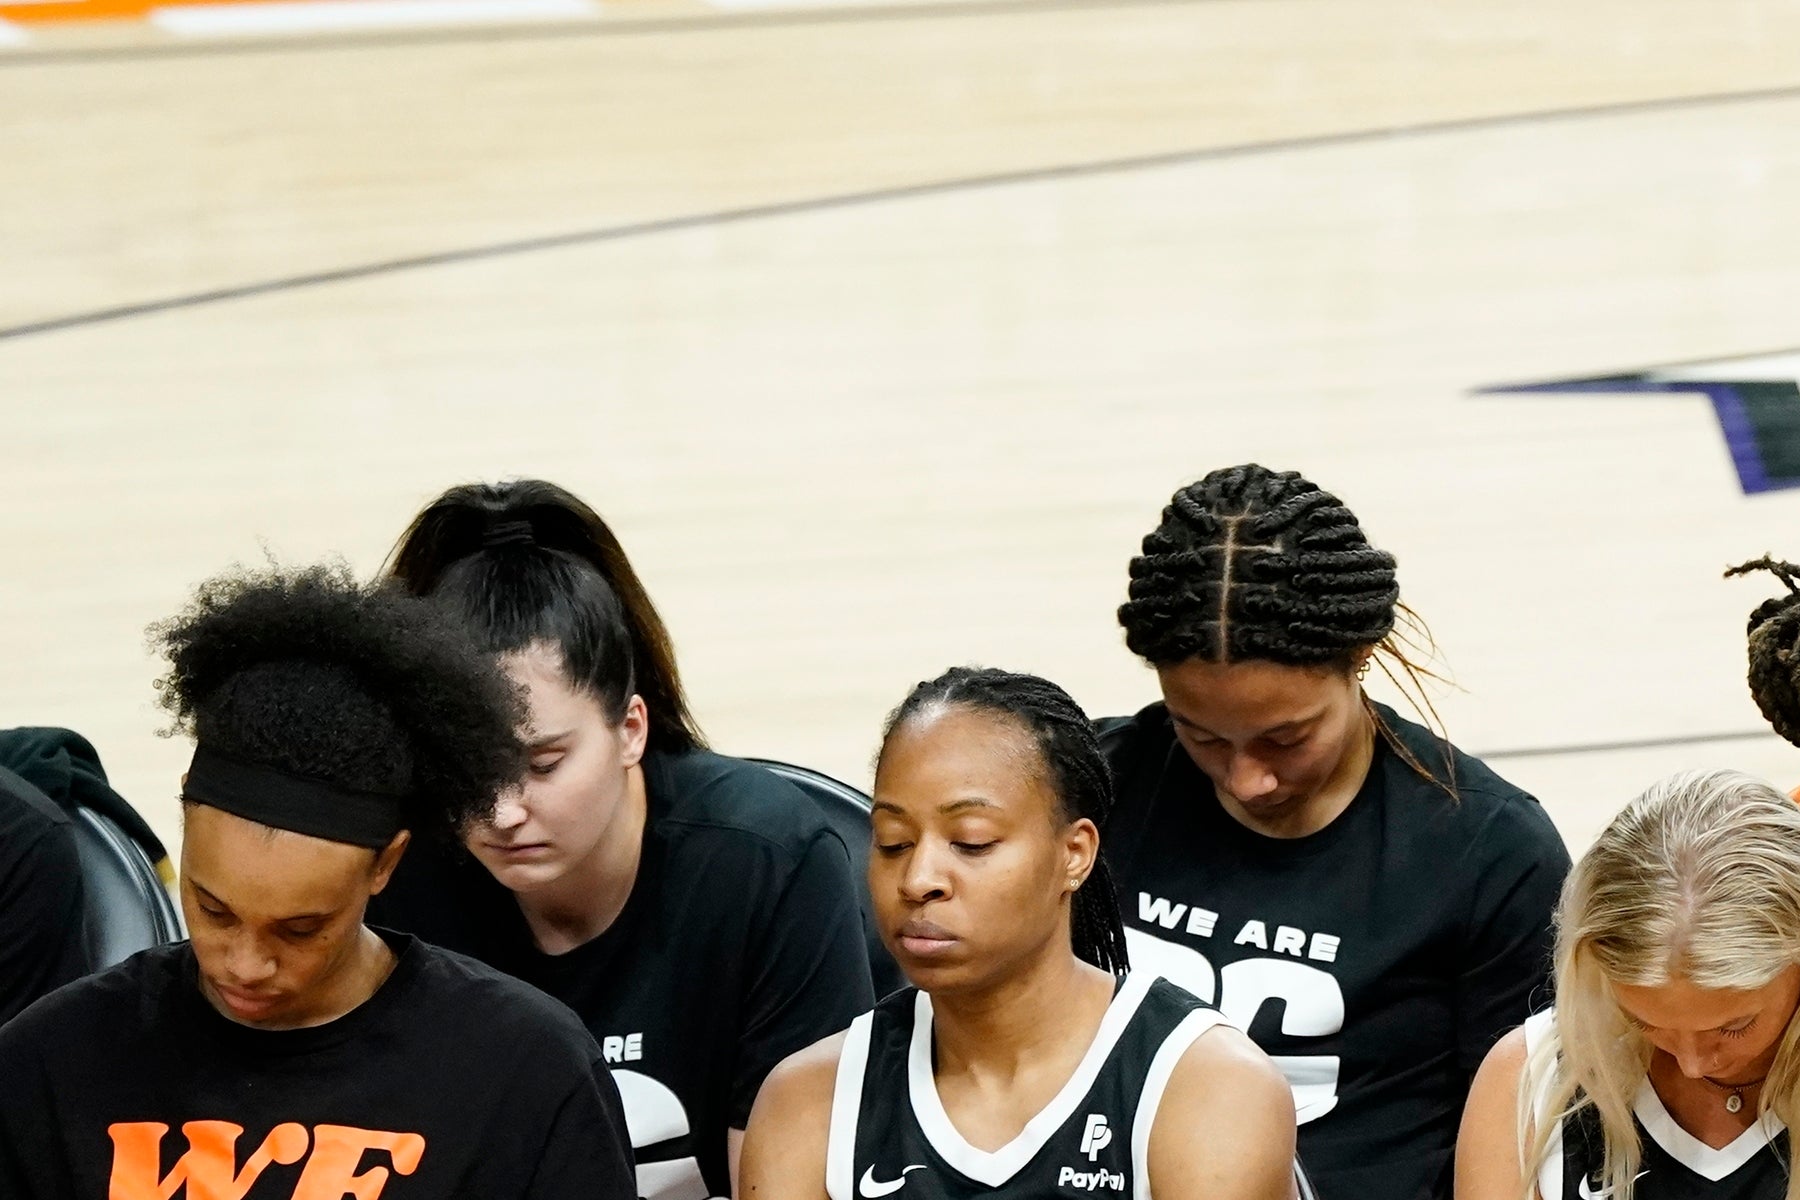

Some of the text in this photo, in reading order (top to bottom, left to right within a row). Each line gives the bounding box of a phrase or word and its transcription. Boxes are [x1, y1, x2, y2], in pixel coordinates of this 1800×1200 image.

[1138, 891, 1341, 963] WE ARE
[603, 1032, 643, 1063] RE
[1058, 1166, 1125, 1191] PayPal
